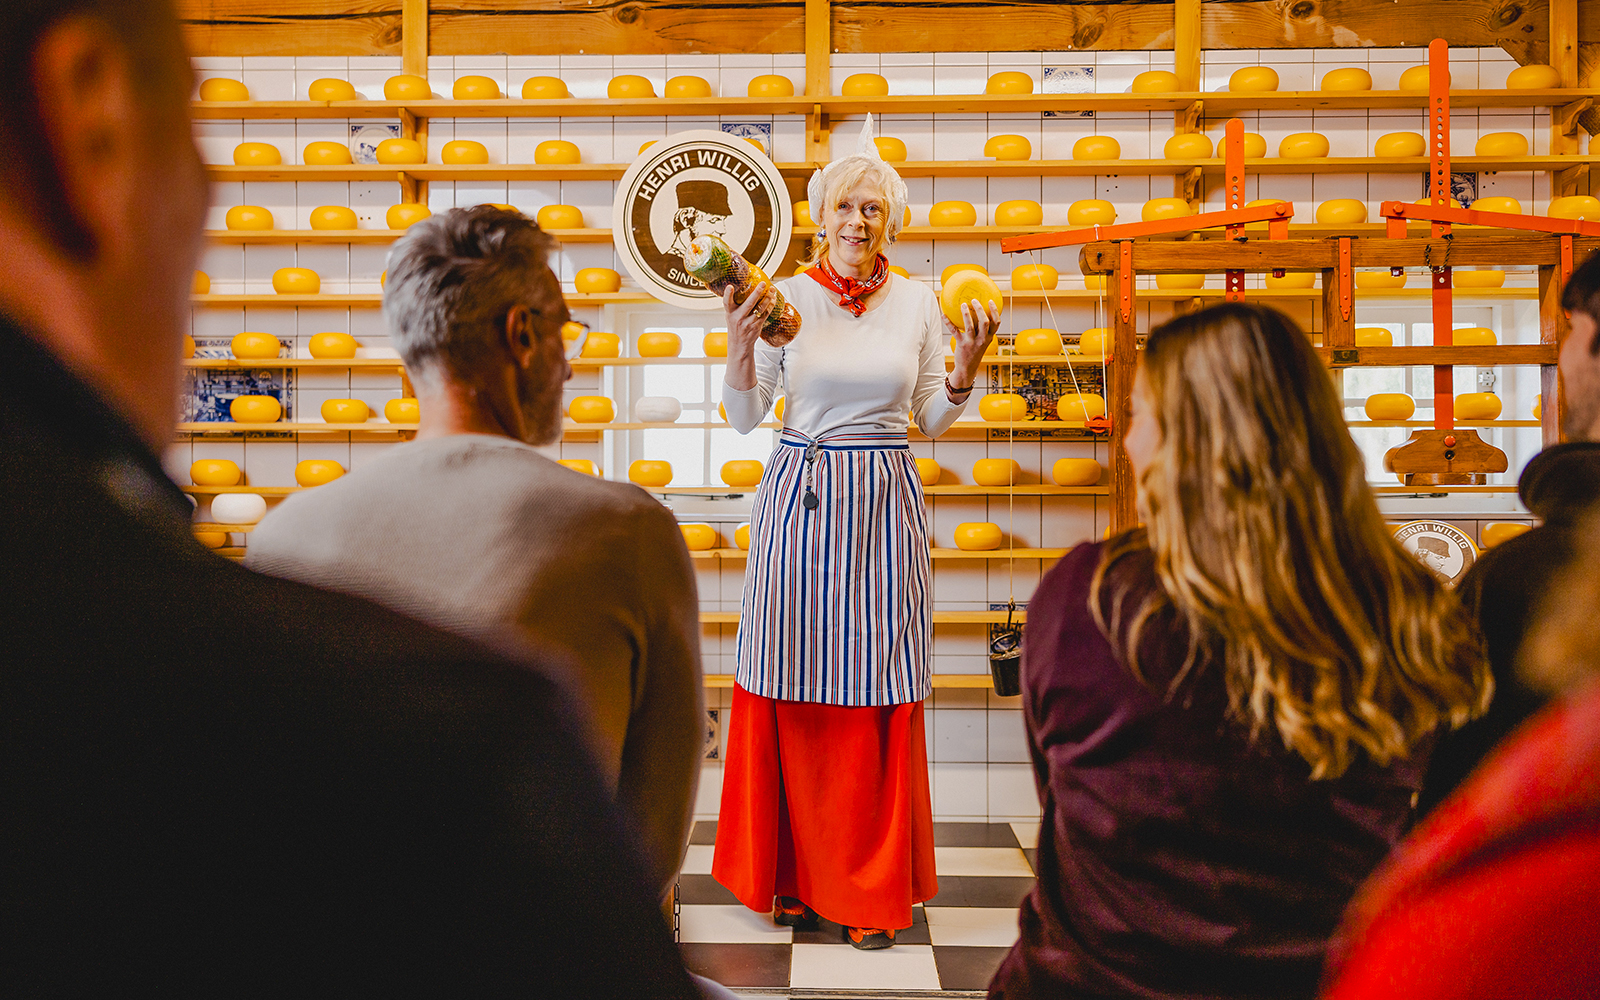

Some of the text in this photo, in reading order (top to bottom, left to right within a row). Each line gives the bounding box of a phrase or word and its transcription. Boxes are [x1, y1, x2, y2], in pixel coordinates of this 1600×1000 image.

[638, 150, 760, 200] HENRI WILLIG
[1432, 524, 1468, 549] WILLIG
